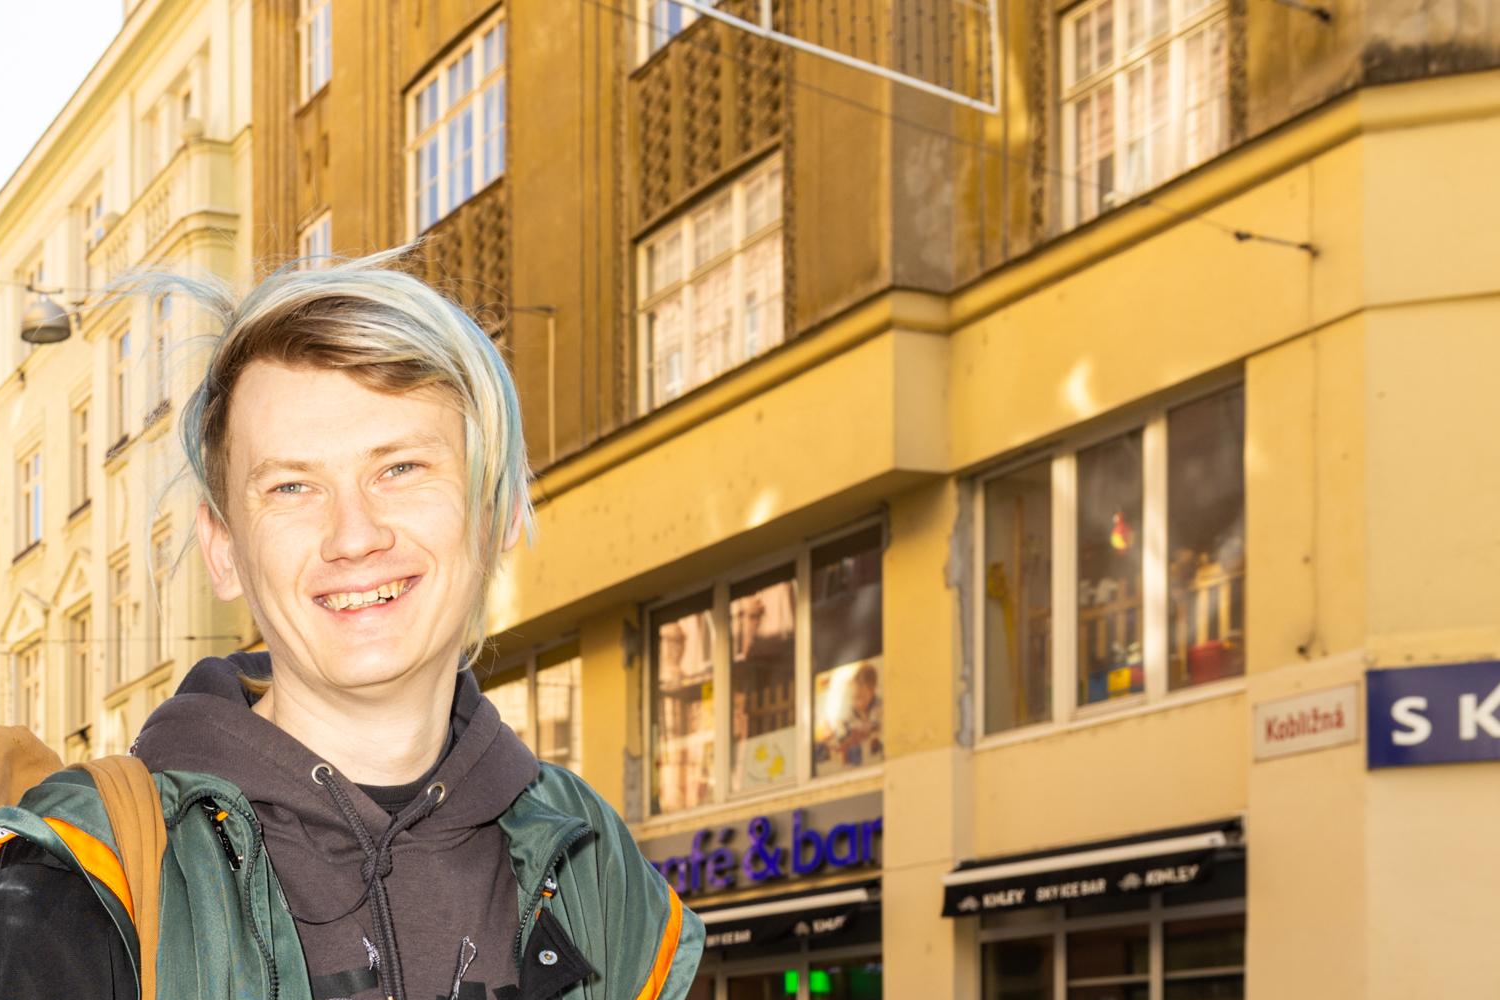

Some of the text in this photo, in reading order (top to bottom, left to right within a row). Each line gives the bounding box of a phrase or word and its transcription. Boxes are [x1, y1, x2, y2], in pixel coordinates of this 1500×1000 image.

[1264, 703, 1346, 742] Kobližná
[743, 816, 782, 881] &
[792, 808, 882, 874] bar
